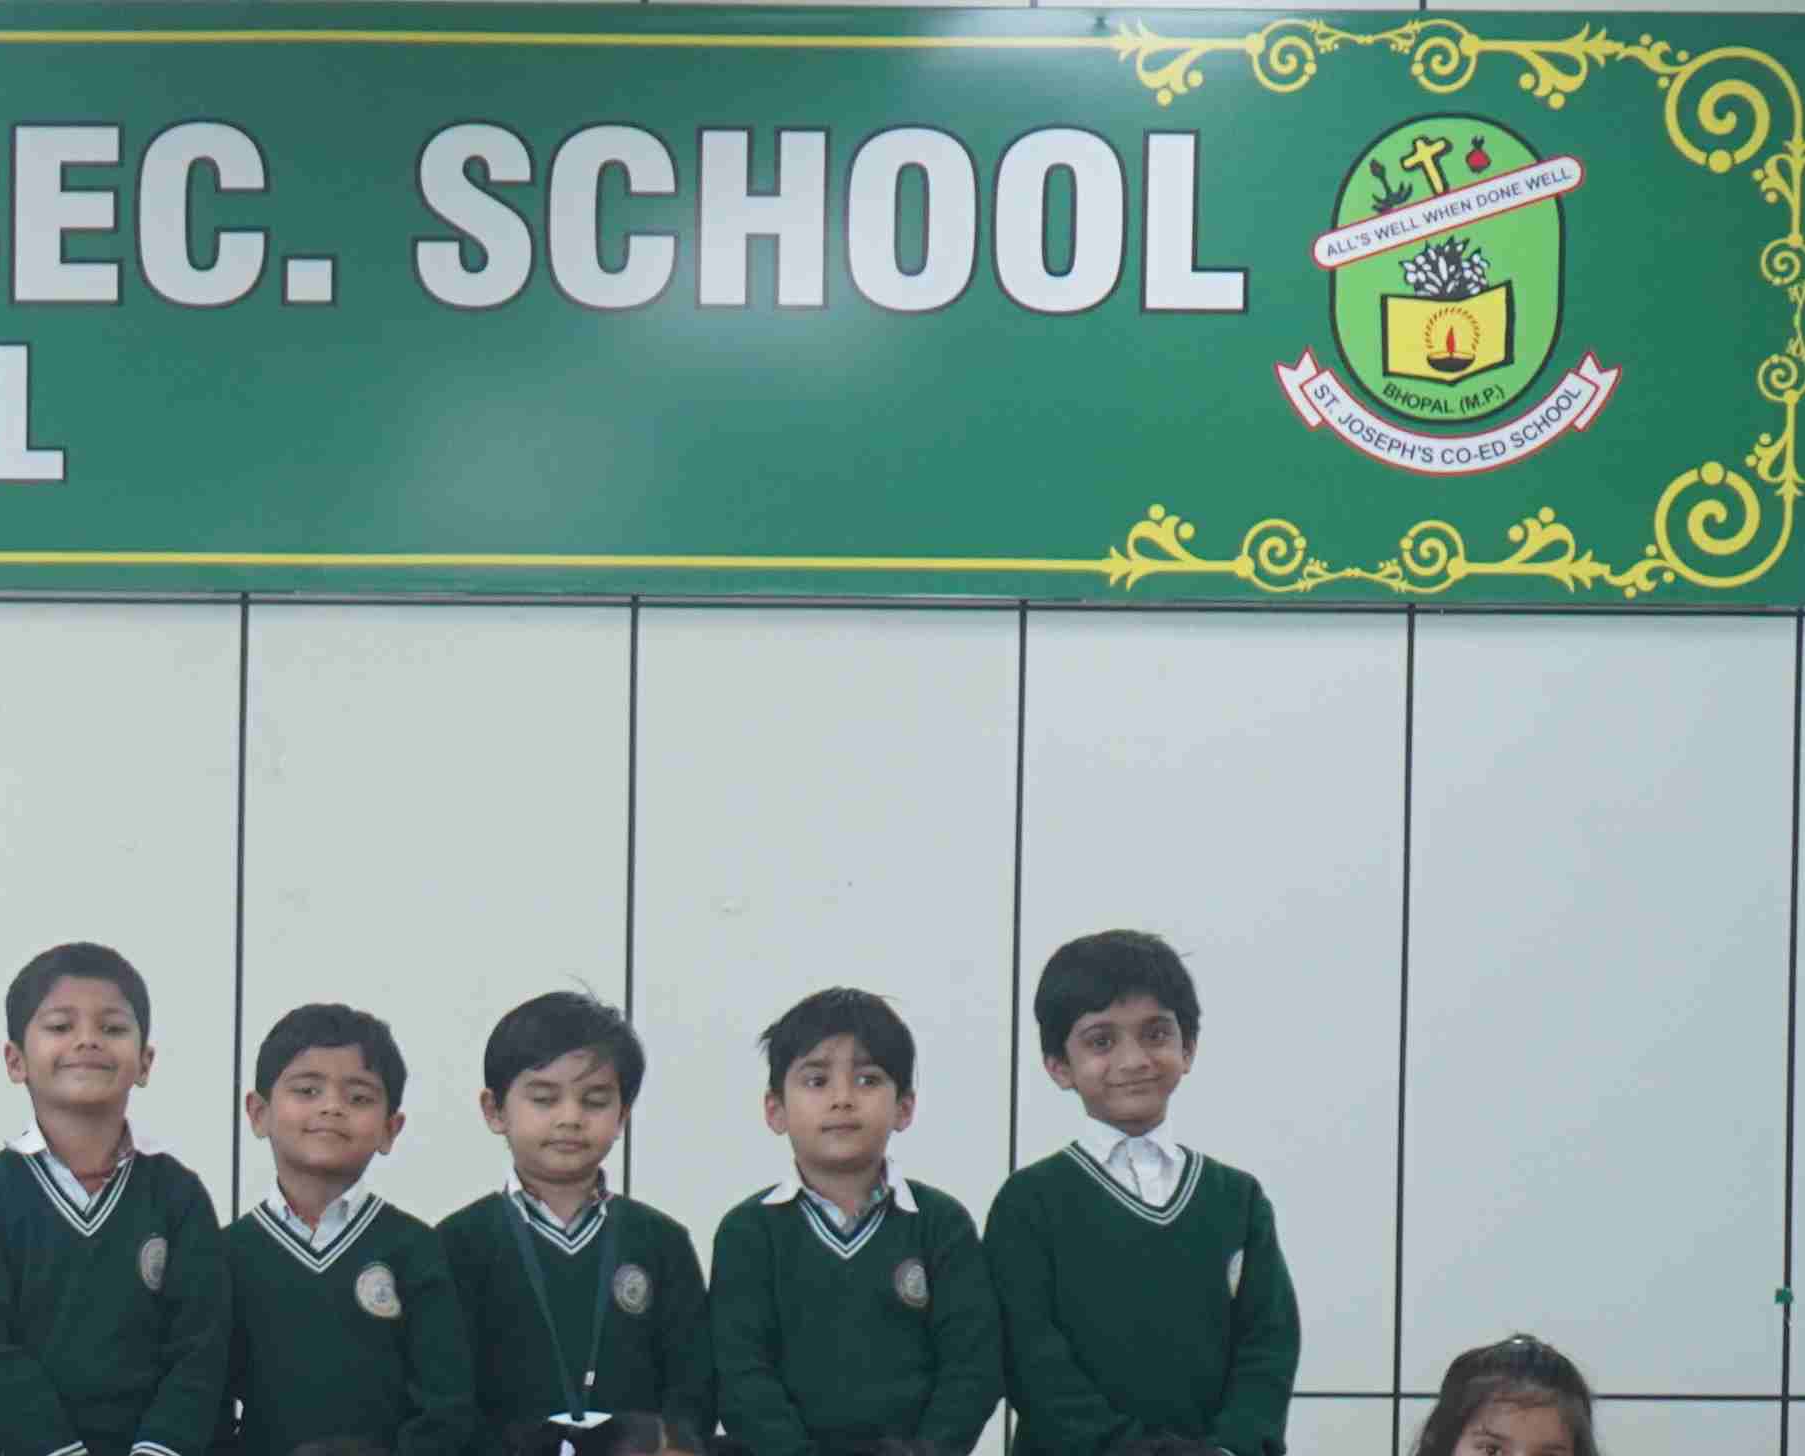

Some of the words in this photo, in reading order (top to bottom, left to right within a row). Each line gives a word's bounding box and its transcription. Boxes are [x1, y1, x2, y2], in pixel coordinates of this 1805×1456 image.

[415, 126, 1247, 315] SCHOOL
[1326, 233, 1372, 258] ALL'S
[1374, 218, 1419, 242] WELL
[1422, 200, 1474, 226] WHEN
[1476, 183, 1522, 207] DONE
[1525, 166, 1573, 191] WELL
[1313, 382, 1341, 416] ST.
[1337, 412, 1434, 464] JOSEPH'S
[1441, 439, 1507, 465] CO-ED
[1509, 385, 1583, 448] SCHOOL
[1382, 383, 1455, 414] BHOPAL
[1459, 383, 1506, 414] (M.P.)
